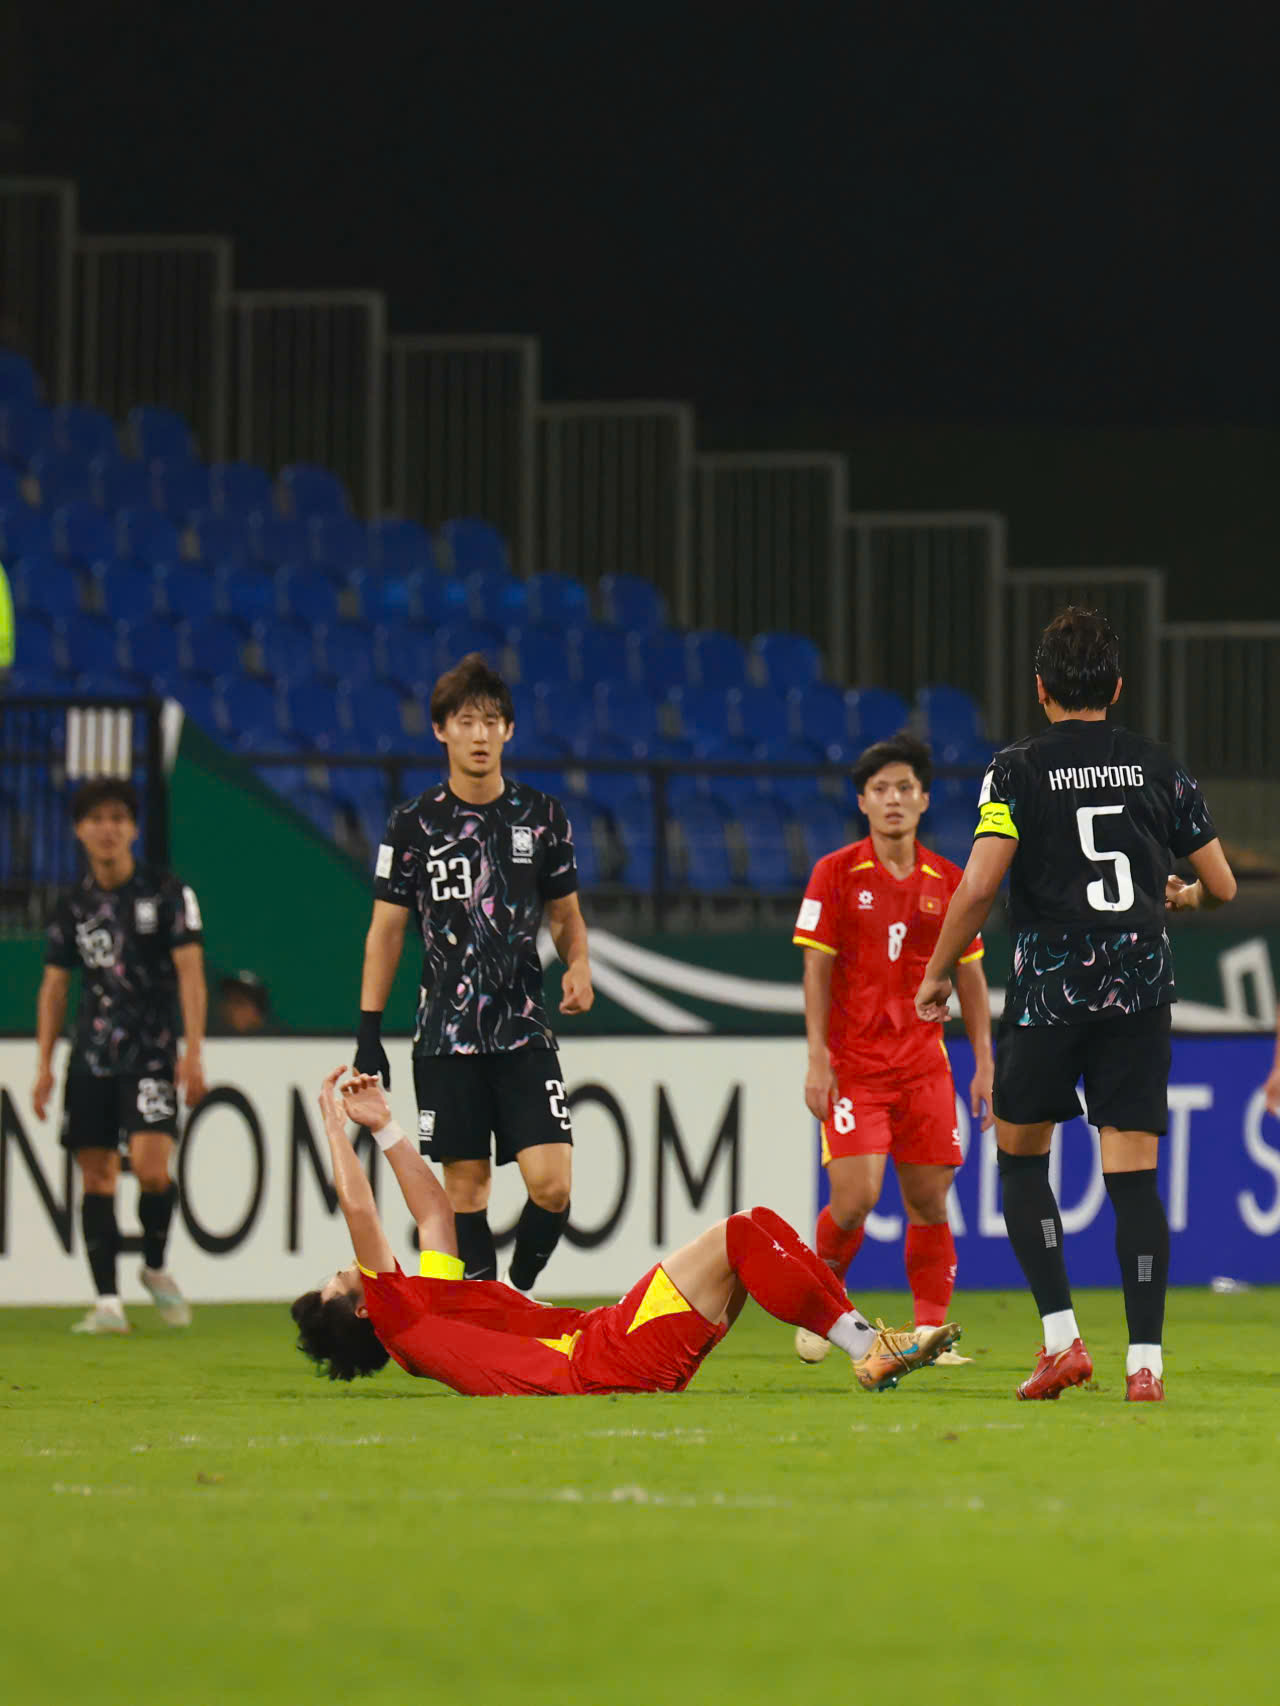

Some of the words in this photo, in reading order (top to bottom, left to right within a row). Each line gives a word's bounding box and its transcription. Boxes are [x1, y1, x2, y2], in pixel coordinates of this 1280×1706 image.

[1048, 765, 1144, 791] HYUNYONG
[426, 856, 473, 901] 23
[1075, 804, 1135, 912] 5
[888, 921, 908, 963] 8
[833, 1097, 856, 1135] 8
